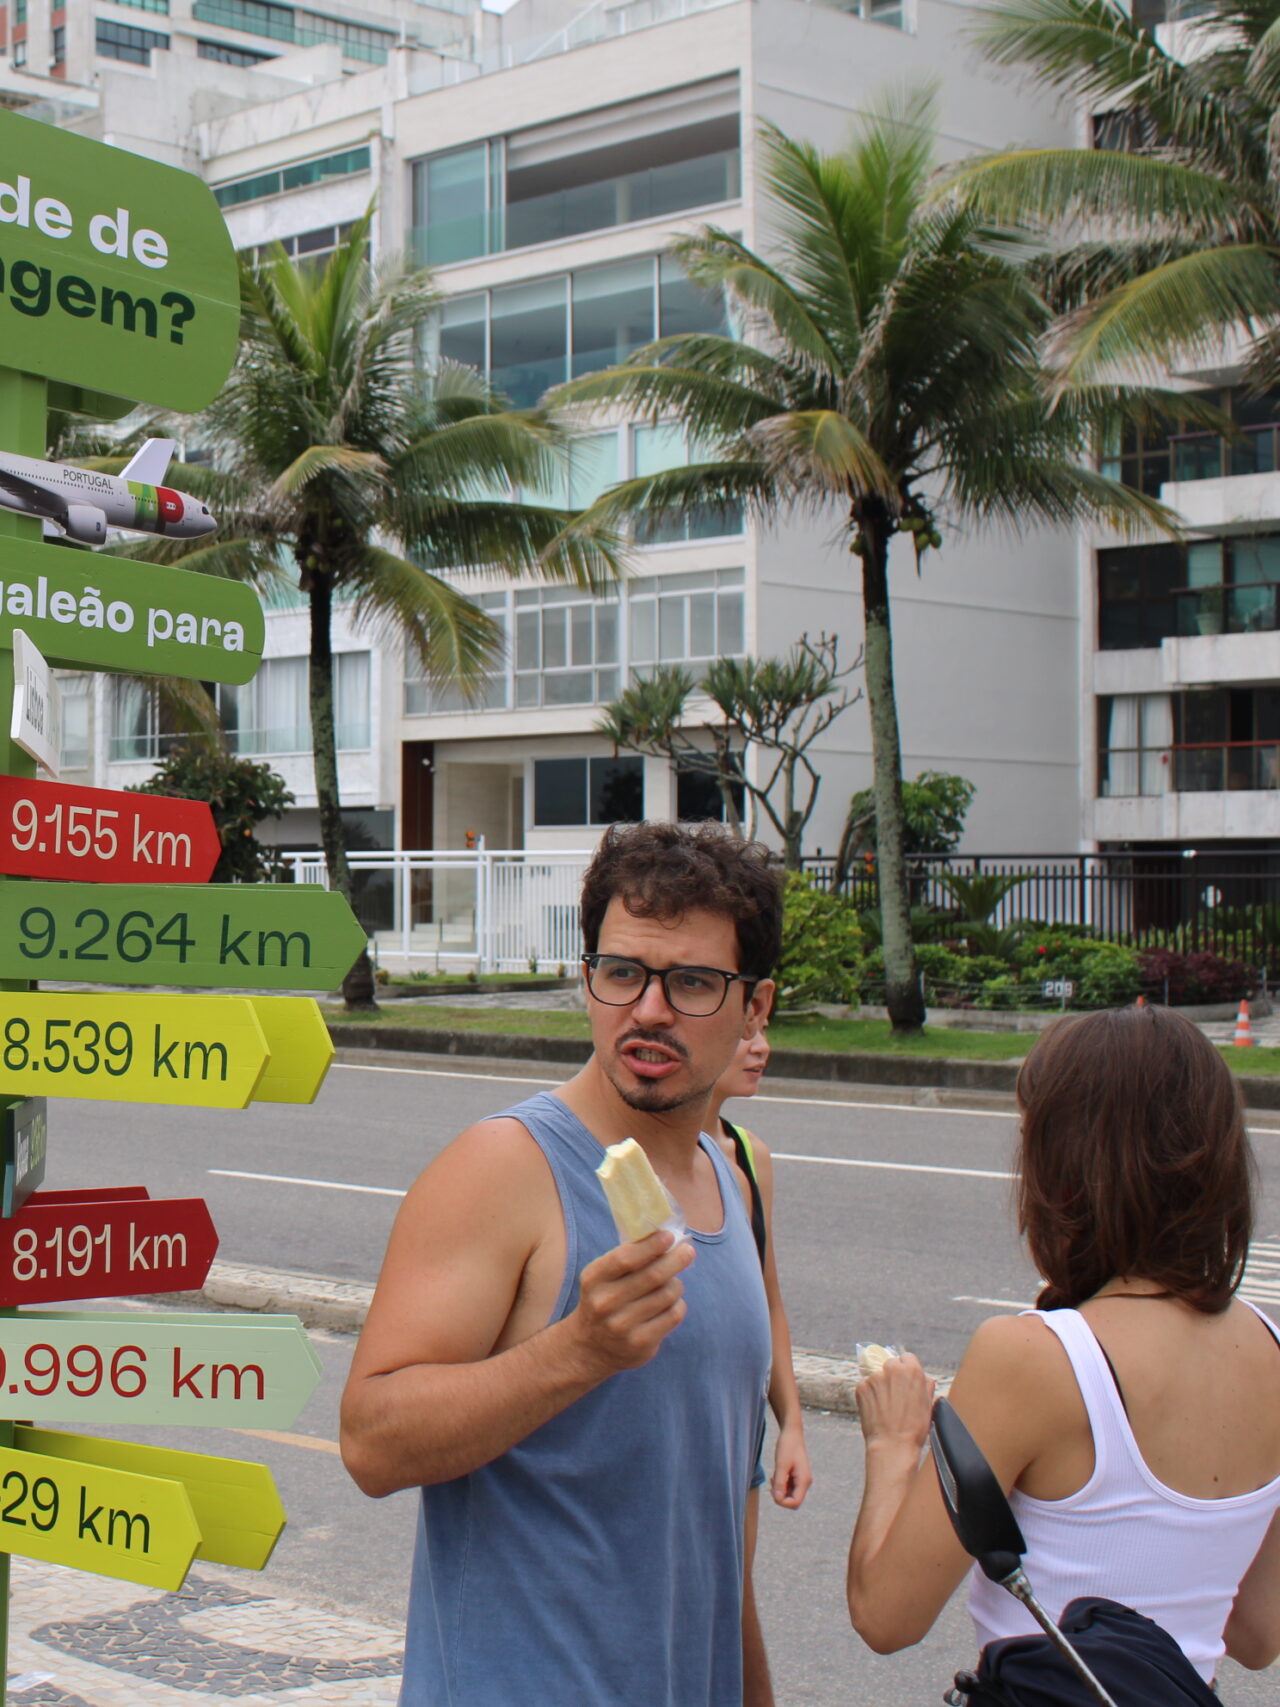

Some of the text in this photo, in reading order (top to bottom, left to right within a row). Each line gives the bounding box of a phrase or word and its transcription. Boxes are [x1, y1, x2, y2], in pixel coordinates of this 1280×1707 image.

[89, 208, 168, 268] de
[63, 469, 113, 490] PORTUGAL
[147, 607, 244, 652] para
[11, 800, 119, 859] 9.155
[132, 814, 192, 867] km
[19, 907, 195, 964] 9.264
[220, 914, 311, 967] km
[3, 1019, 133, 1074] 8.539
[153, 1023, 228, 1080] km
[12, 1224, 111, 1281] 8.191
[128, 1222, 186, 1270] km
[173, 1347, 265, 1399] km
[79, 1488, 150, 1552] km
